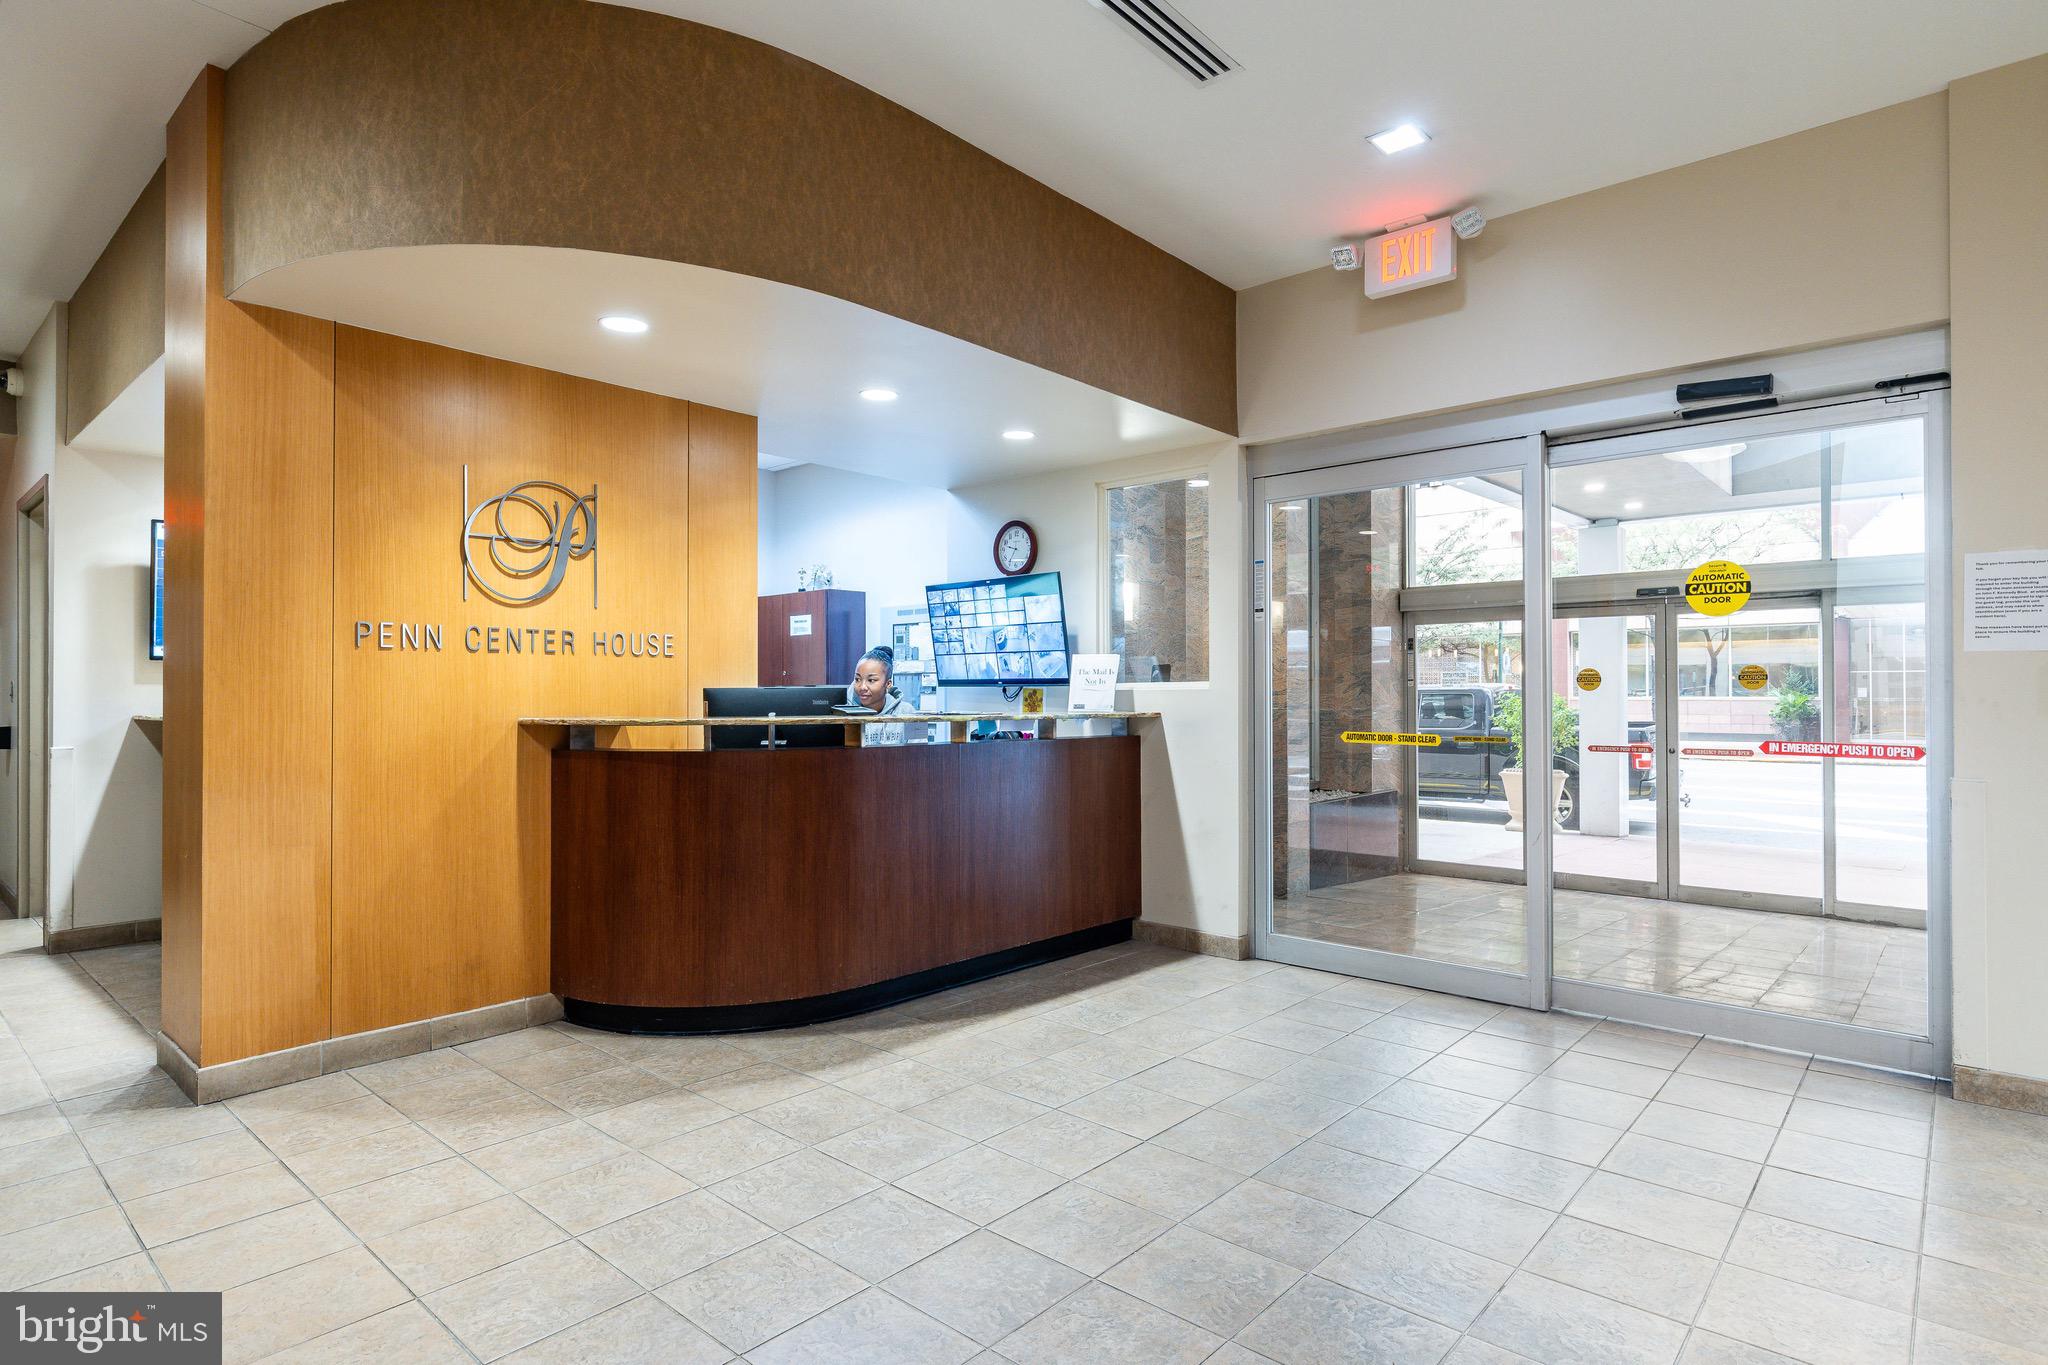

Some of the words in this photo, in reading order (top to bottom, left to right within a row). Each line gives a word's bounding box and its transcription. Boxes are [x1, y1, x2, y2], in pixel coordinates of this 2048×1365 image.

[1381, 227, 1437, 284] EXIT
[1692, 572, 1745, 582] AUTOMATIC
[1688, 582, 1747, 594] CAUTION
[1704, 596, 1731, 604] DOOR
[356, 620, 444, 651] PENN
[464, 625, 575, 655] CENTER
[592, 631, 675, 657] HOUSE
[1346, 733, 1377, 741] AUTOMATIC
[1397, 735, 1417, 743] STAND
[1417, 736, 1437, 744] CLEAR
[1768, 742, 1779, 753] IN
[1781, 743, 1840, 755] EMERGENCY
[1842, 745, 1869, 756] PUSH
[1871, 746, 1884, 757] TO
[1887, 747, 1915, 758] OPEN
